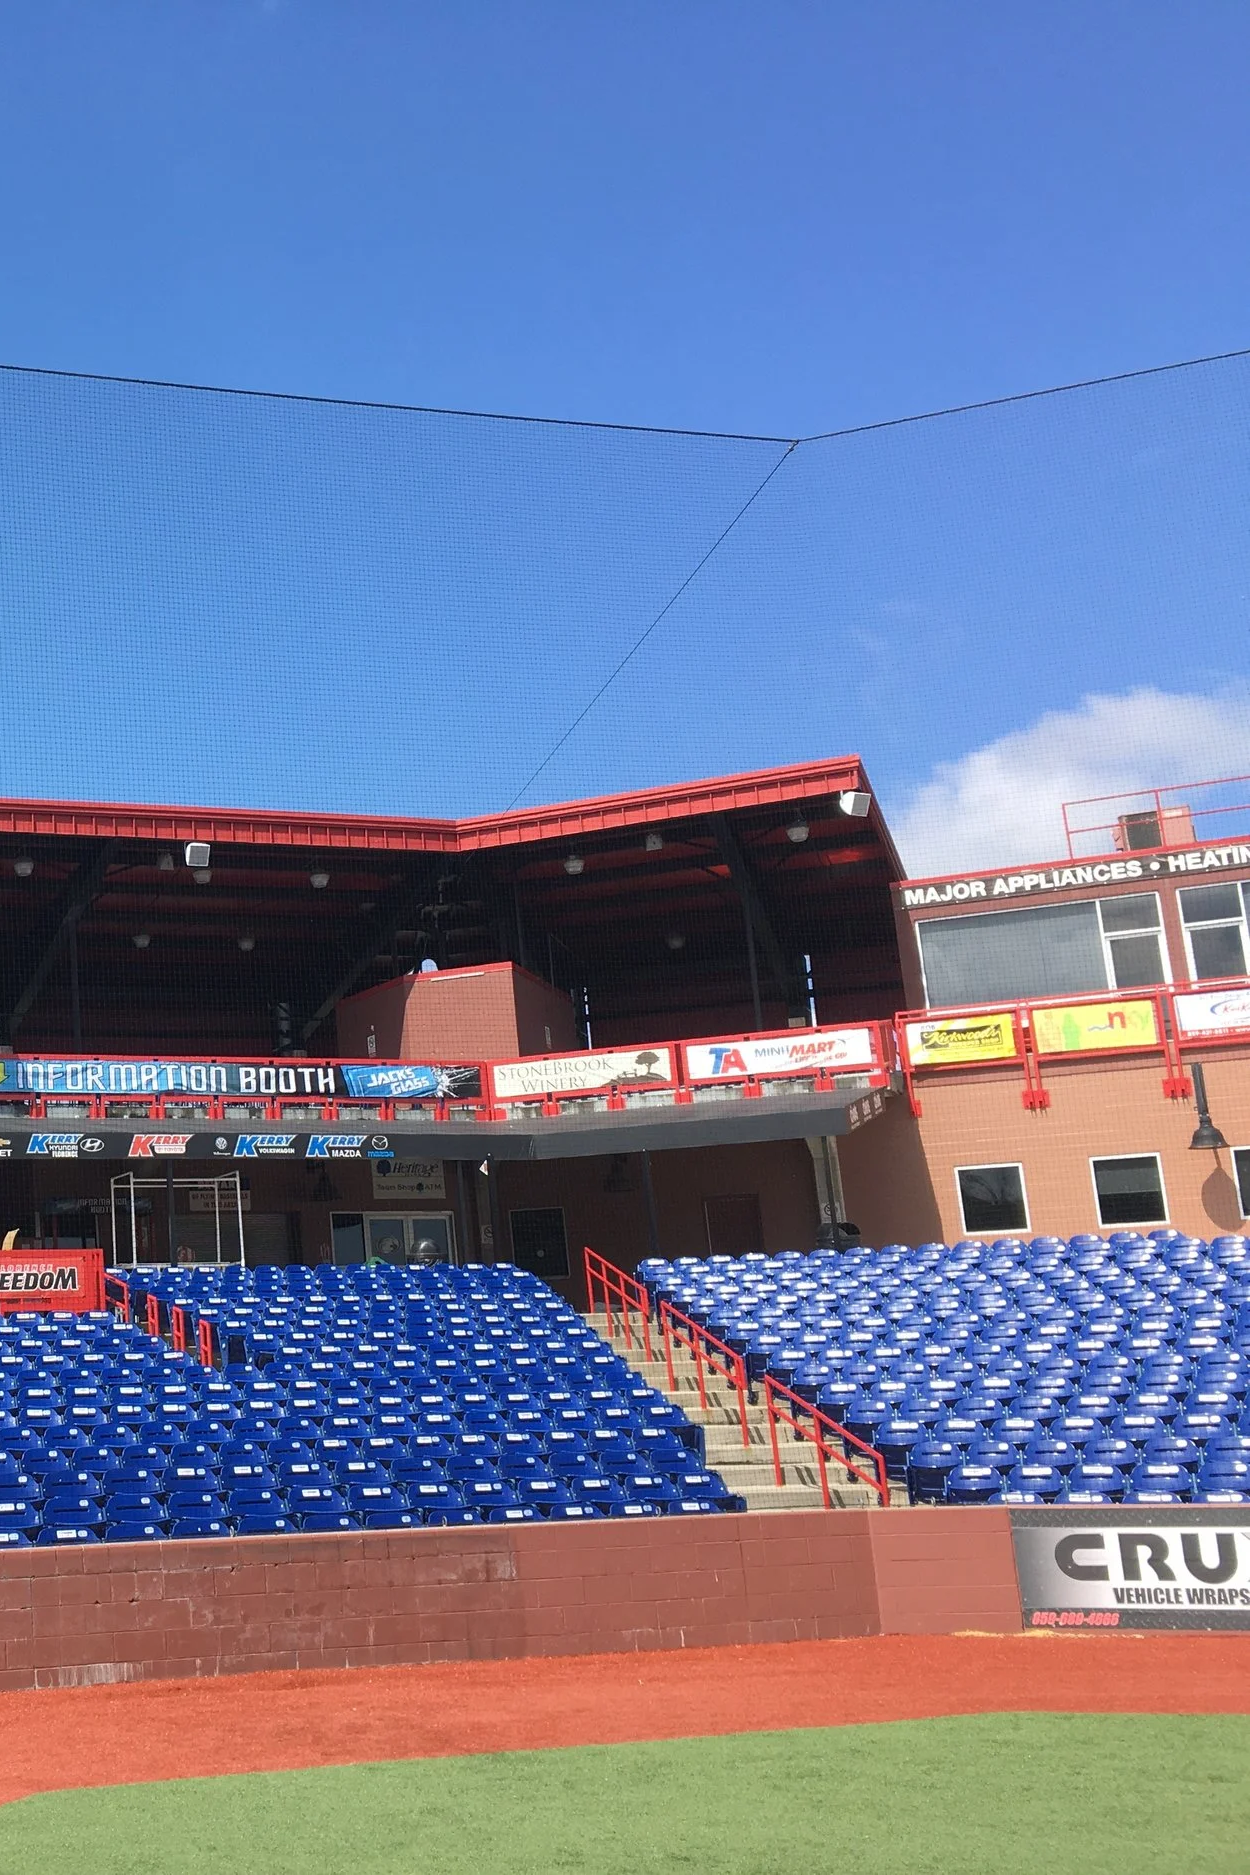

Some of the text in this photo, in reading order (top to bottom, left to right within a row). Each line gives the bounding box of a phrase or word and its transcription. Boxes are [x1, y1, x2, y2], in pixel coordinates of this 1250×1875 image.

[904, 882, 986, 907] MAJOR
[992, 860, 1143, 896] APPLIANCES
[708, 1047, 748, 1075] TA
[788, 1040, 836, 1058] MART
[16, 1062, 336, 1094] INFORMATION BOOTH
[390, 1076, 431, 1095] GLASS
[25, 1132, 85, 1155] KERRY
[128, 1133, 196, 1157] KERRY
[233, 1133, 301, 1157] KERRY
[258, 1146, 295, 1154] VOLKSWAGEN
[304, 1134, 368, 1158] KERRY
[331, 1149, 362, 1158] MAZDA
[392, 1162, 439, 1177] Heritage
[1054, 1532, 1250, 1585] CRU
[1113, 1587, 1250, 1606] VEHICLE WRAPS
